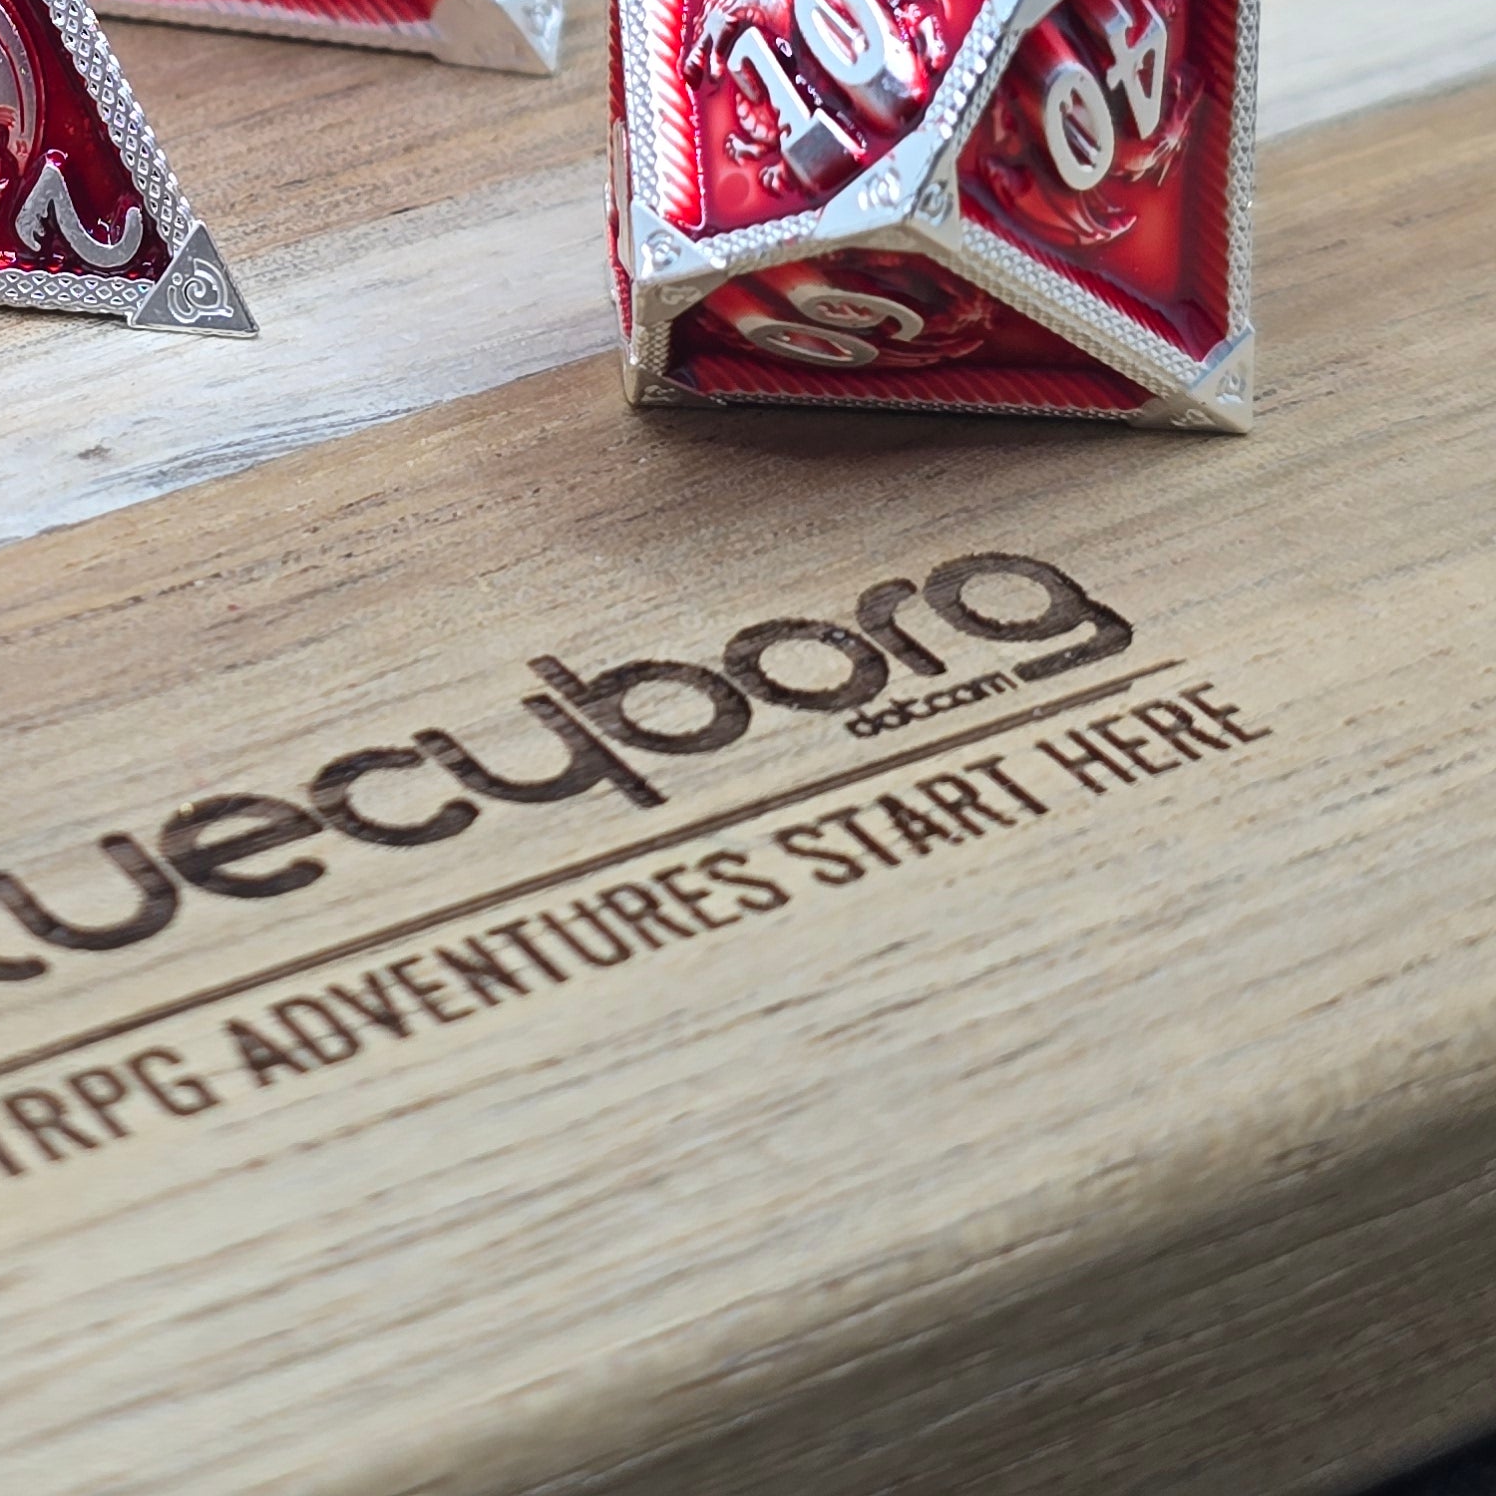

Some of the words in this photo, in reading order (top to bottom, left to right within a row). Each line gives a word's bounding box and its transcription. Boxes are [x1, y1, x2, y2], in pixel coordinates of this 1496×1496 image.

[1044, 12, 1168, 192] 40
[844, 670, 1019, 740] dotcom
[224, 850, 792, 1090] ADVENTURES
[774, 754, 1052, 890] START
[1036, 682, 1274, 797] HERE
